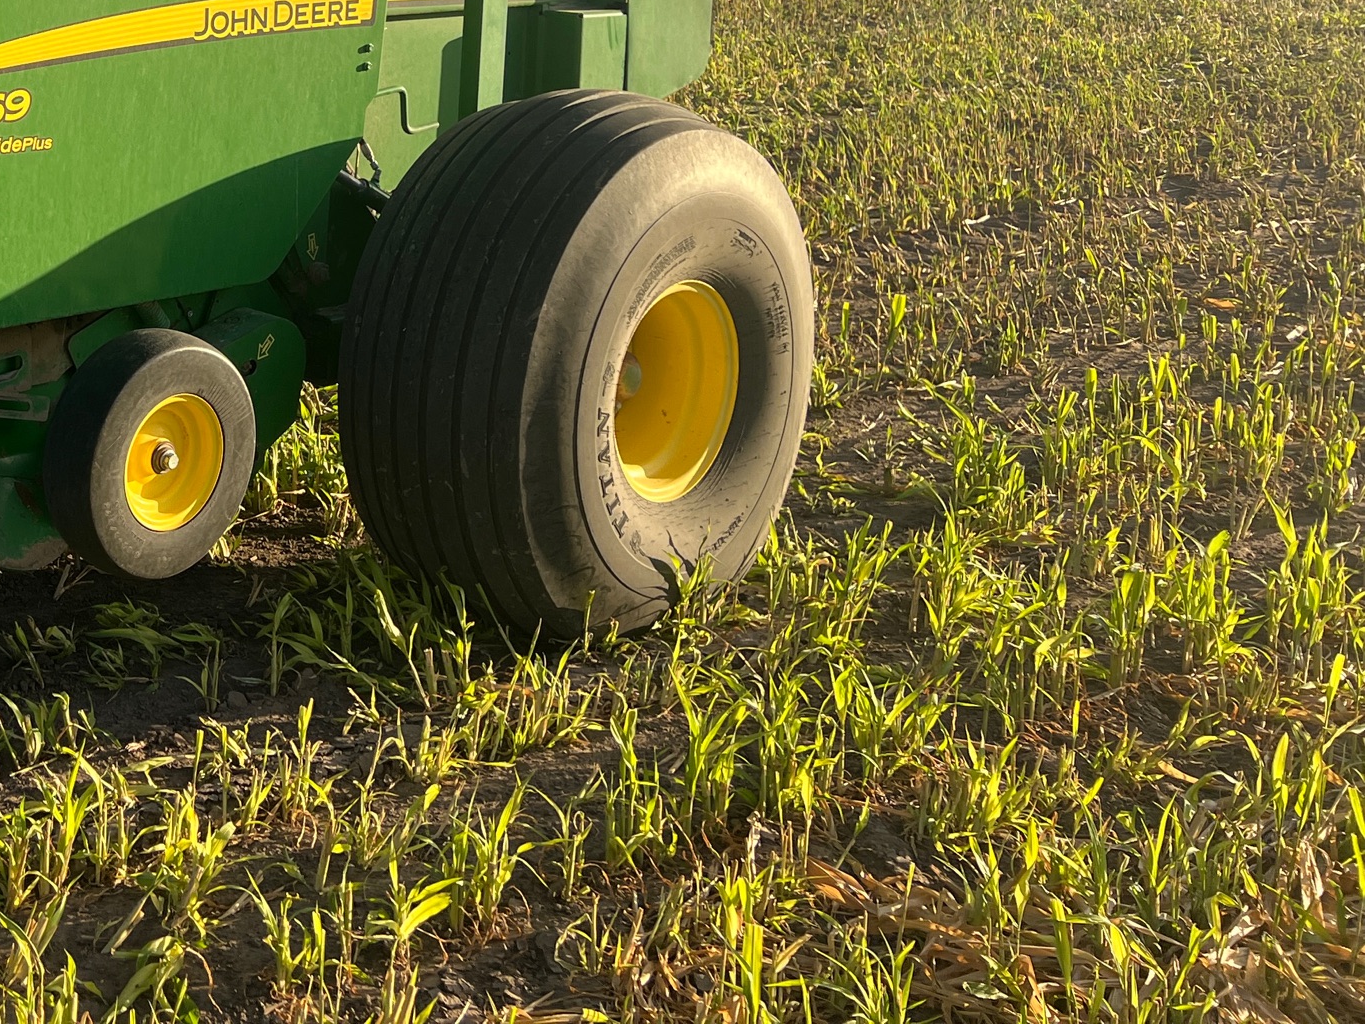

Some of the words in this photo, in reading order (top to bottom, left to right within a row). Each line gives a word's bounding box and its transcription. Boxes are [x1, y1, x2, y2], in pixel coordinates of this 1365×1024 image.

[194, 5, 268, 37] JOHN
[273, 0, 359, 27] DEERE
[597, 407, 629, 539] TITAN
